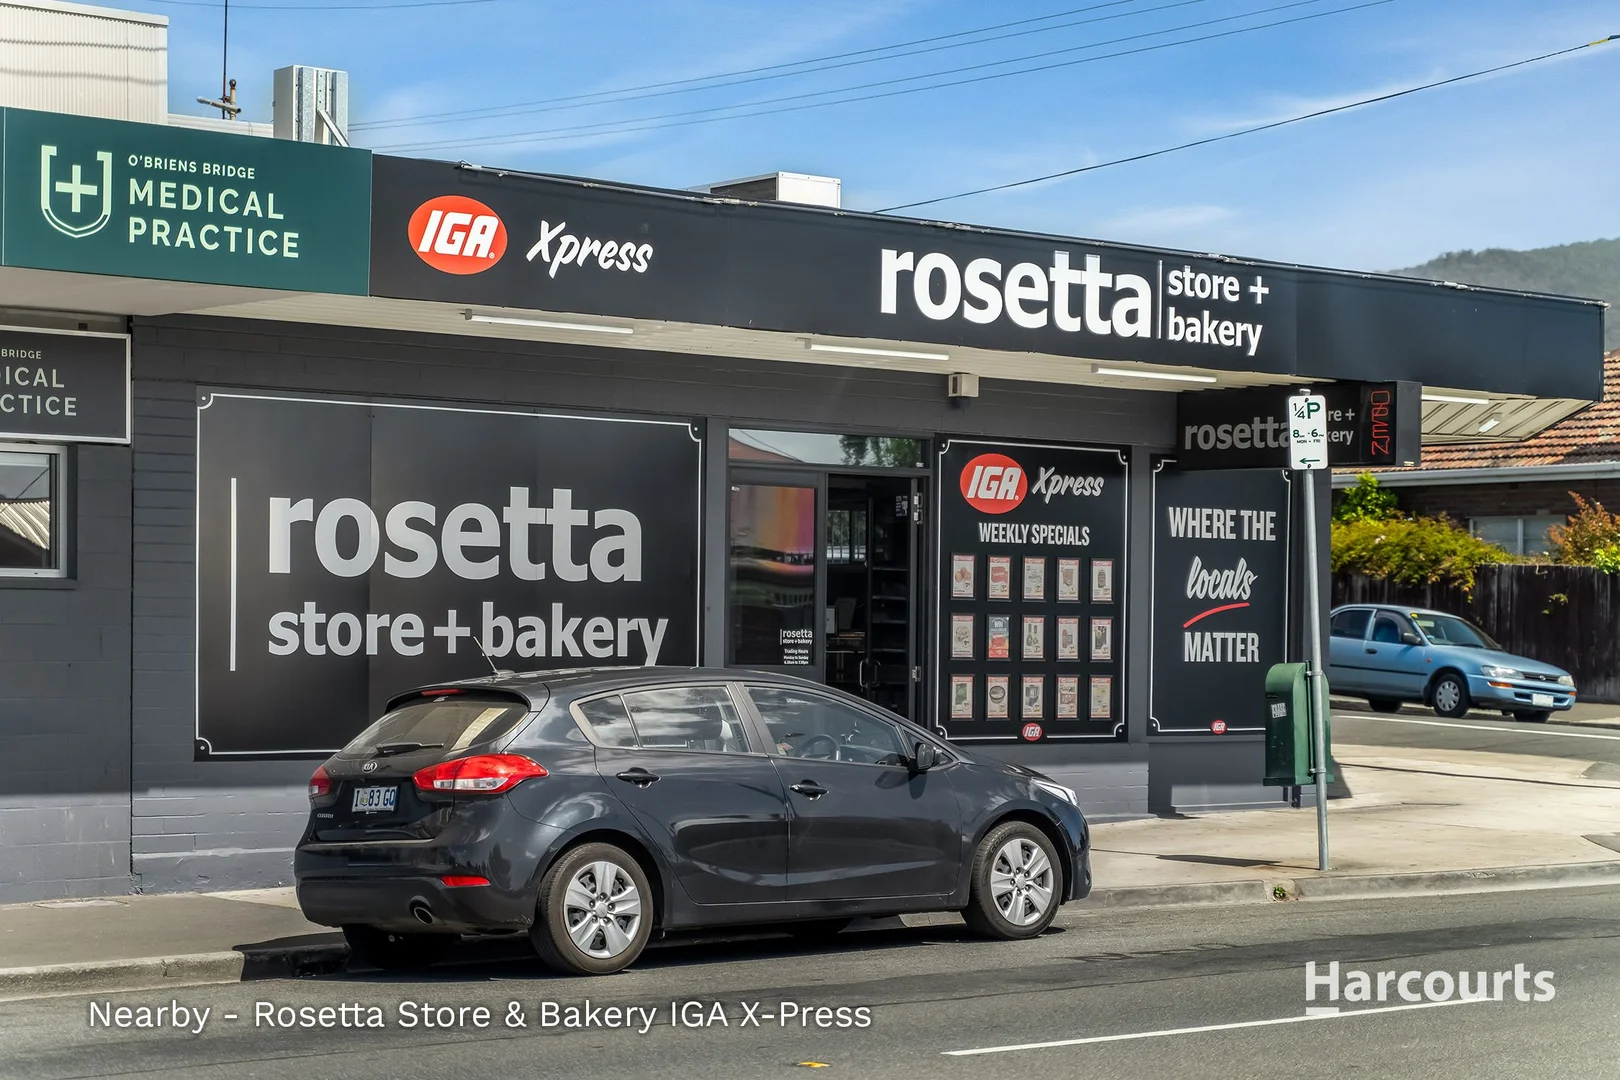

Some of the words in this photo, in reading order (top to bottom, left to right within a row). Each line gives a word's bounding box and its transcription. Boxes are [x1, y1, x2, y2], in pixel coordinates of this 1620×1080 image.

[128, 154, 197, 173] O'BRIENS
[203, 162, 255, 179] BRIDGE
[129, 178, 284, 220] MEDICAL
[129, 216, 299, 258] PRACTICE
[417, 209, 499, 259] IGA
[526, 219, 653, 279] Xpress
[880, 248, 1152, 338] rosetta
[1166, 264, 1240, 302] store
[1166, 306, 1263, 356] bakery
[1, 348, 42, 359] BRIDGE
[0, 366, 65, 388] ICAL
[1184, 416, 1290, 451] rosetta
[966, 465, 1022, 500] IGA
[1031, 466, 1105, 504] Xpress
[268, 486, 642, 583] rosetta
[978, 522, 1030, 544] WEEKLY
[1031, 524, 1091, 547] SPECIALS
[1168, 506, 1237, 540] WHERE
[1240, 510, 1277, 541] THE
[1186, 555, 1259, 600] locals
[268, 601, 425, 657] store
[482, 601, 669, 667] bakery
[782, 629, 813, 638] rosetta
[1184, 631, 1260, 663] MATTER
[1024, 726, 1041, 737] IGA
